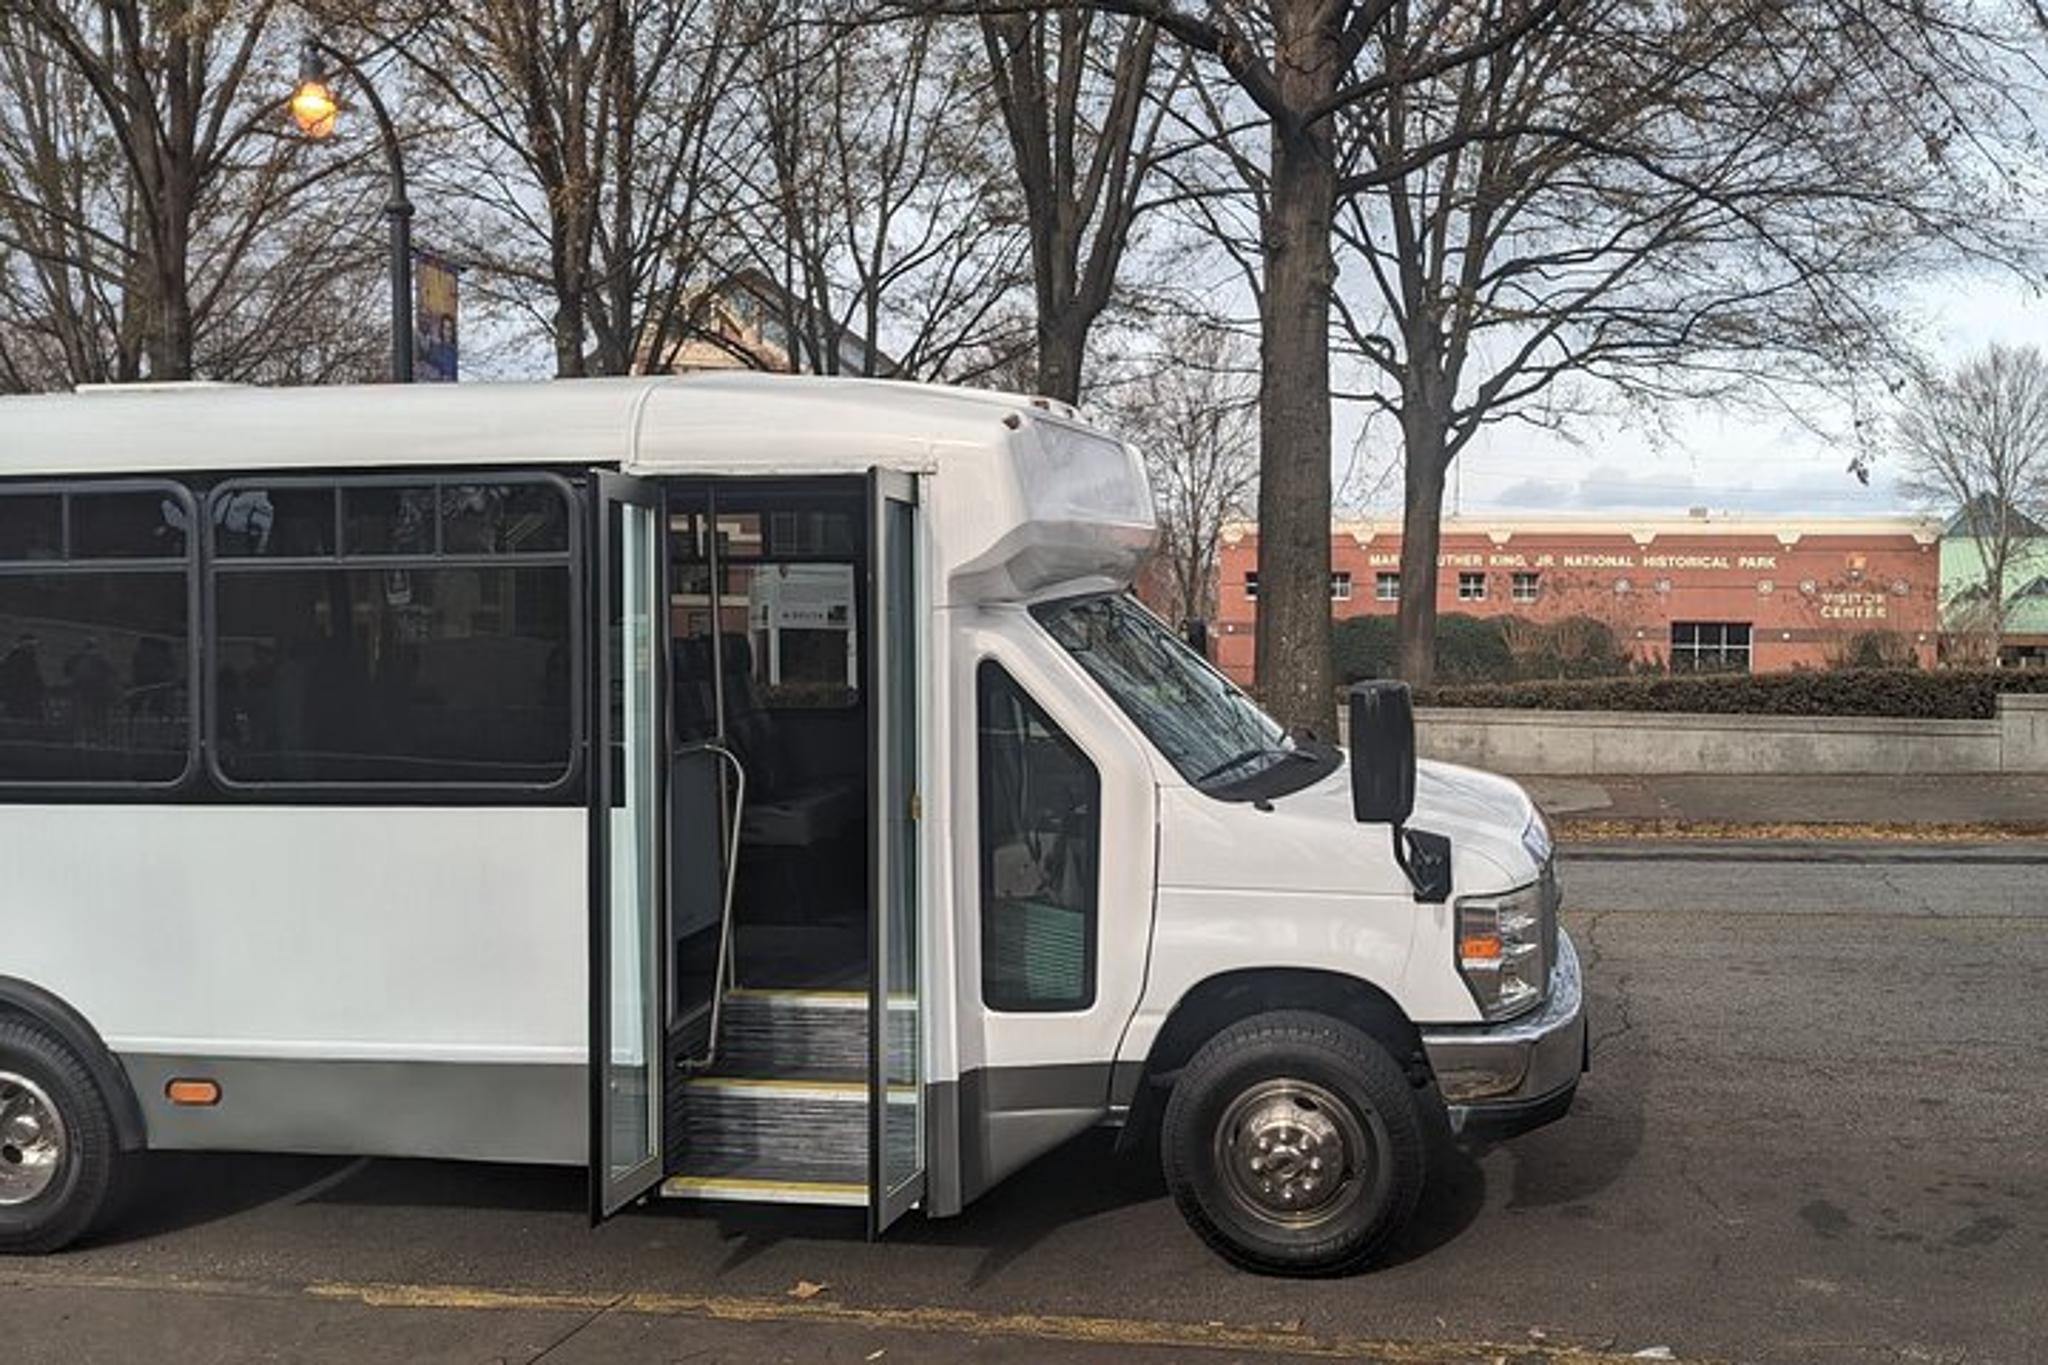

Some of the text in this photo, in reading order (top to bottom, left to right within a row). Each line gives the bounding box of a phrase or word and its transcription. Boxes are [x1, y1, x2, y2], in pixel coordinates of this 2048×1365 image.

[1437, 554, 1483, 567] UTHER
[1563, 555, 1634, 568] NATIONAL
[1642, 556, 1730, 569] HISTORICAL
[1737, 556, 1777, 569] PARK
[1821, 593, 1885, 605] VISITOR
[1820, 606, 1887, 619] CENTER
